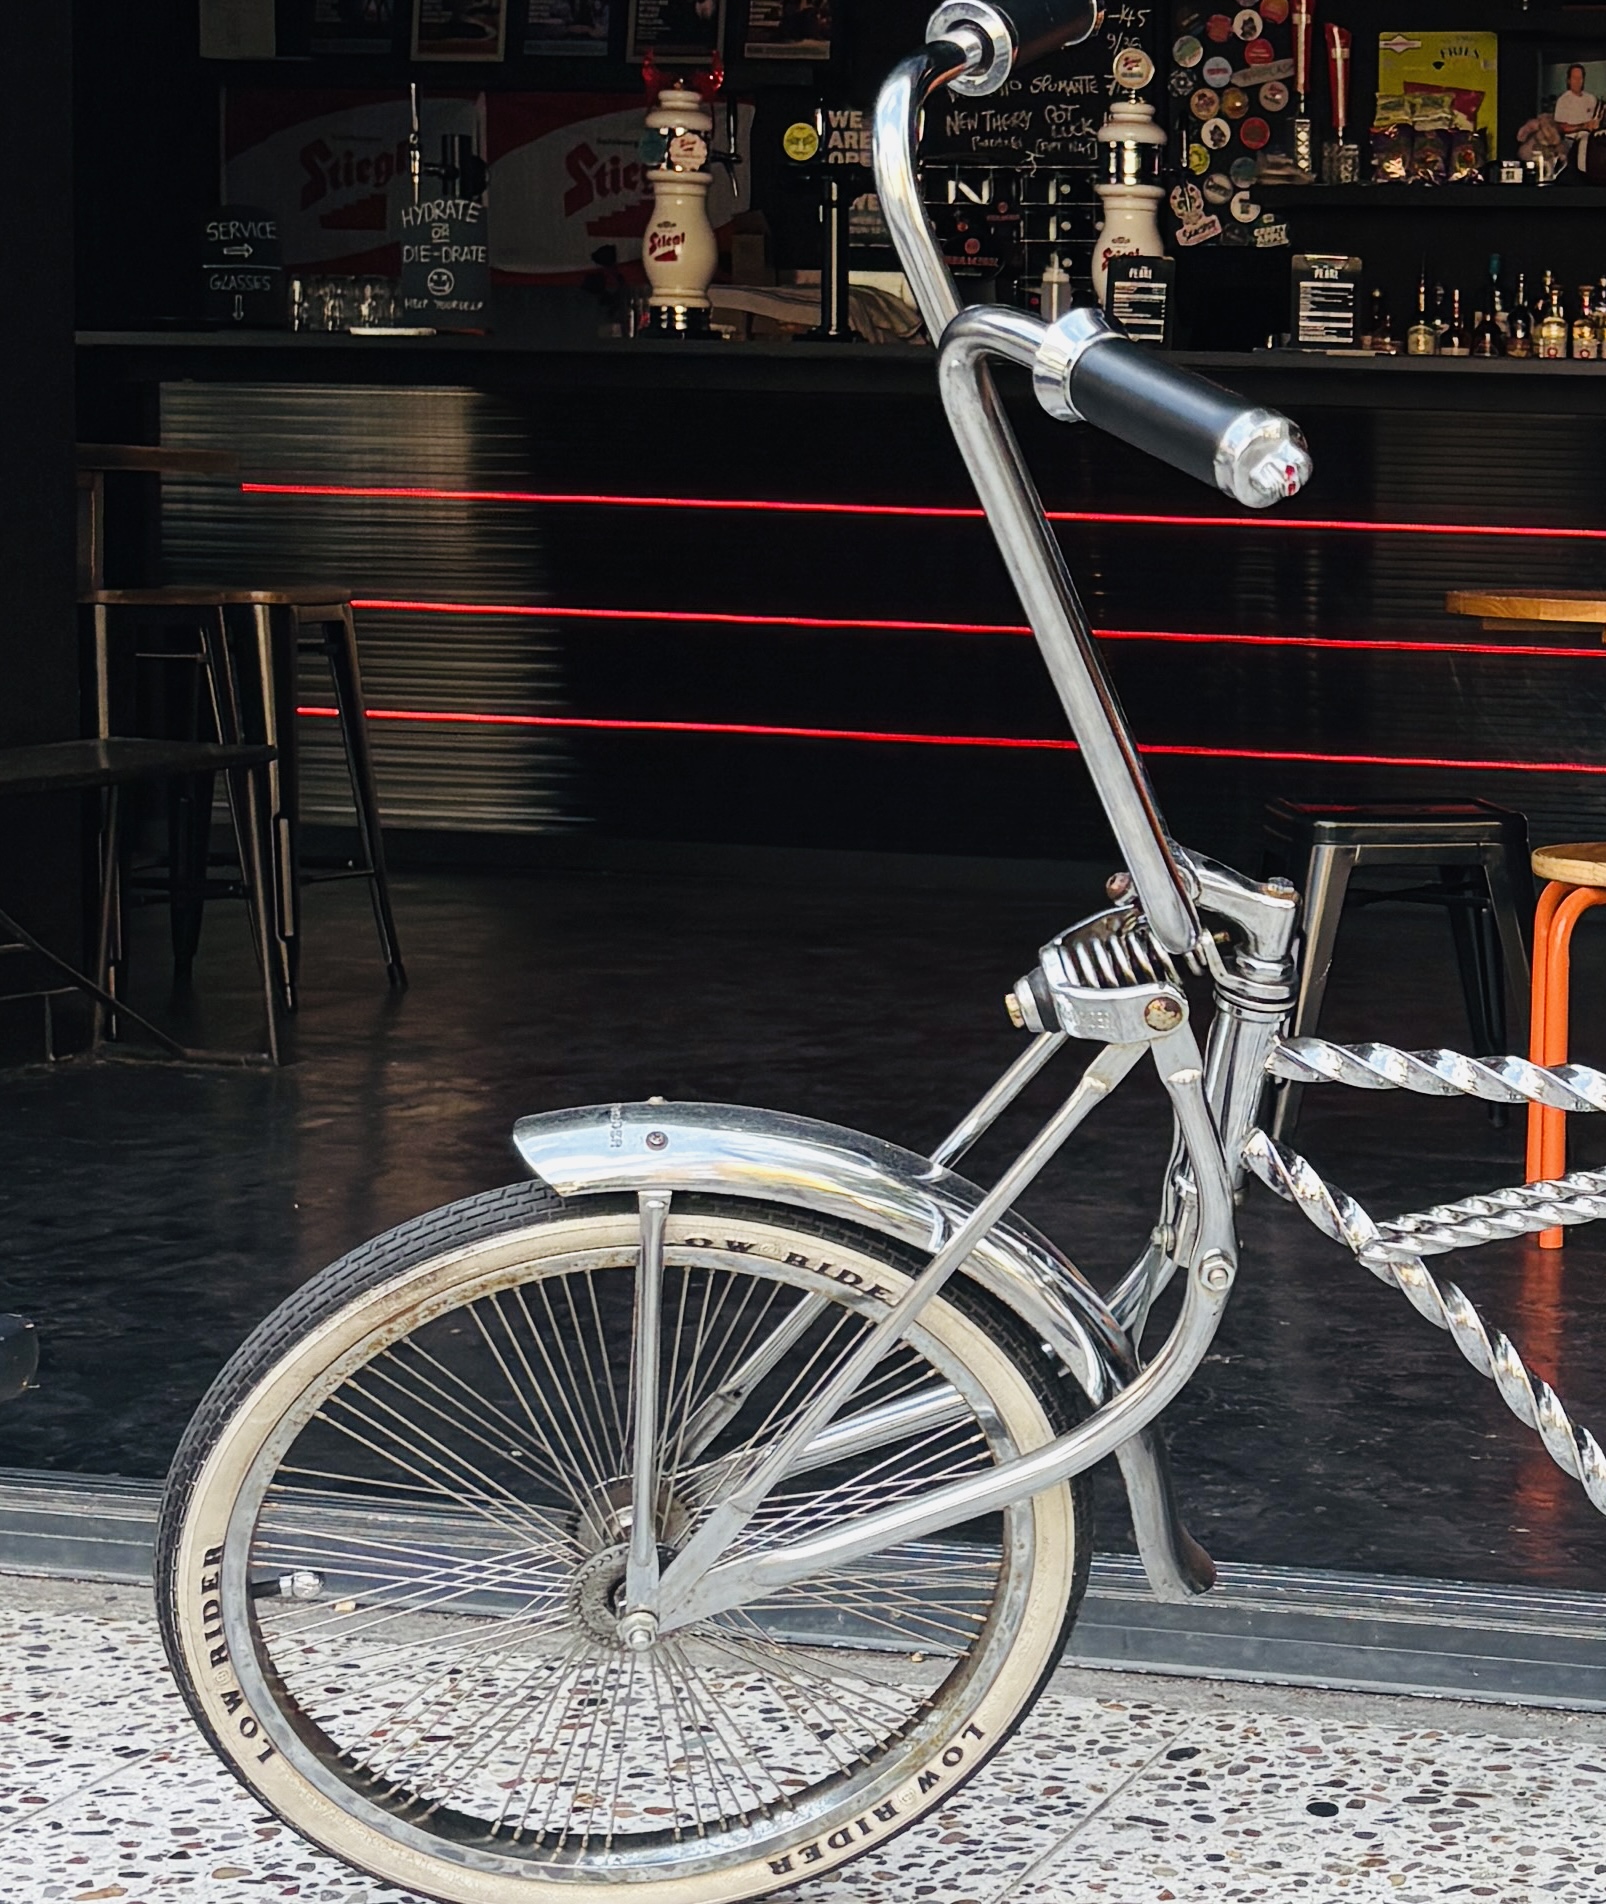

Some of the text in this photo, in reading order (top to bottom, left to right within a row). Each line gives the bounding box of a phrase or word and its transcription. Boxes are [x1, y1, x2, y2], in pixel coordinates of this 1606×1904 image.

[828, 110, 863, 129] WE
[1043, 103, 1081, 123] POT
[945, 110, 979, 137] NEW
[1049, 117, 1100, 139] LUCK
[828, 131, 874, 150] ARE
[828, 152, 875, 167] OPE
[401, 198, 482, 228] HYDRATE
[206, 221, 278, 241] SERVICE
[402, 245, 488, 264] DIE-DRATE
[209, 273, 272, 292] GLASSES
[782, 1251, 898, 1302] RIDE
[201, 1545, 276, 1764] LOW RIDER
[767, 1722, 986, 1877] LOW RIDER
